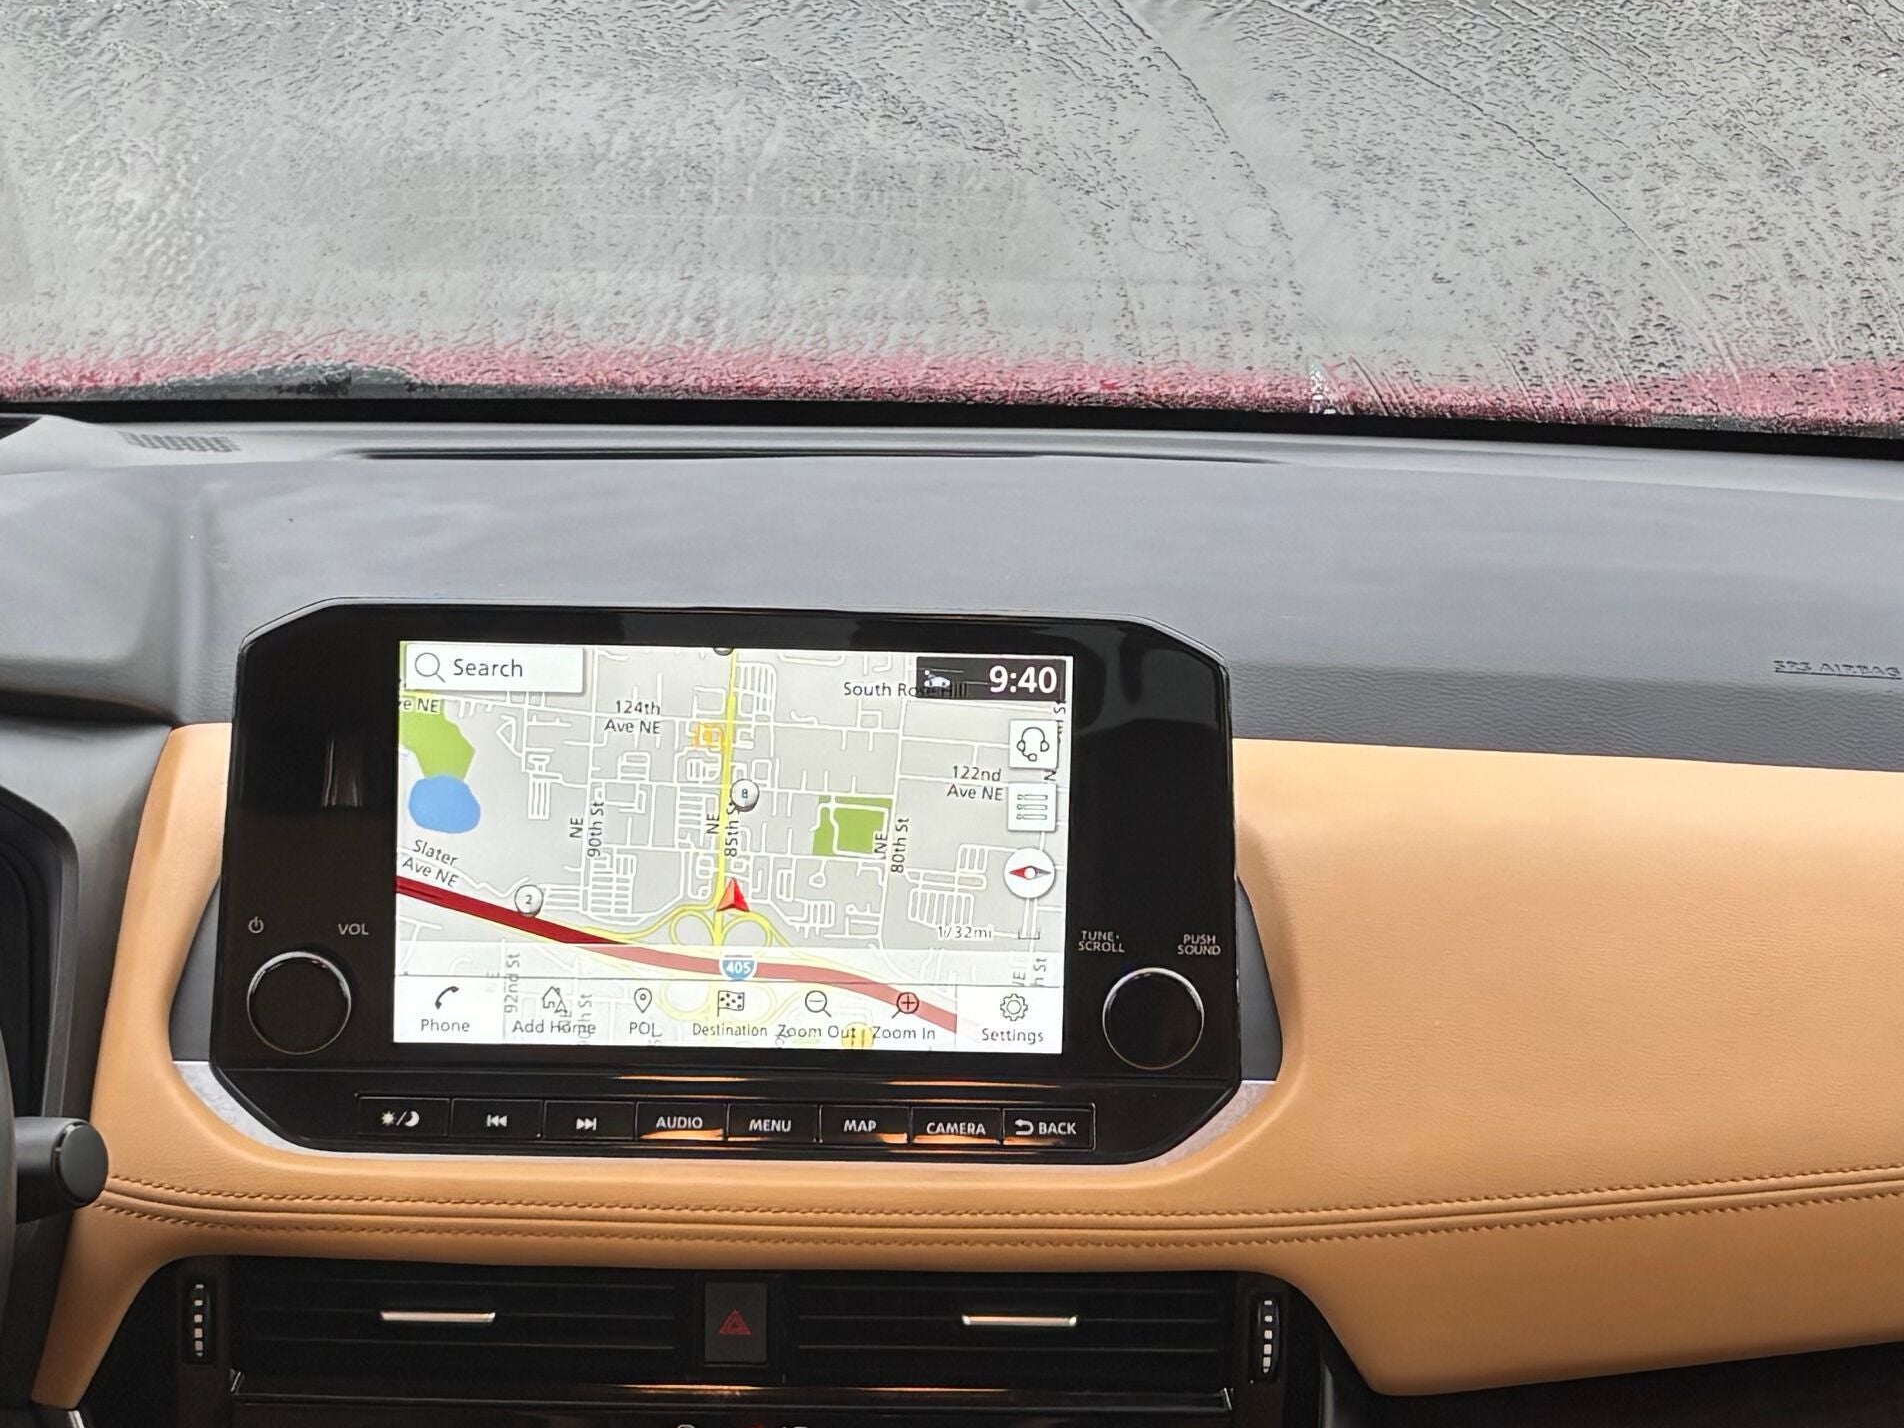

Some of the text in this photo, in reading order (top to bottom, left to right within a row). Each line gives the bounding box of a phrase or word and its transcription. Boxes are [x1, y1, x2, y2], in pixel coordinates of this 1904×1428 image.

[453, 659, 524, 678] Search
[989, 665, 1058, 694] 9:40
[844, 681, 892, 697] South
[417, 698, 440, 713] NE
[615, 700, 662, 716] 124th
[604, 719, 661, 735] Ave NE
[953, 765, 1001, 782] 122nd
[947, 785, 1003, 801] Ave NE
[569, 817, 584, 838] NE
[587, 801, 605, 857] 90th St
[706, 814, 719, 834] NE
[724, 820, 739, 857] 85th
[890, 818, 910, 873] 80th St
[412, 839, 458, 867] Slater
[402, 857, 459, 888] Ave NE
[337, 923, 369, 935] VOL
[1078, 941, 1125, 953] SCROLL
[1183, 934, 1216, 945] PUSH
[1177, 944, 1221, 956] SOUND
[727, 960, 752, 973] 405
[420, 1018, 471, 1033] Phone
[512, 1019, 545, 1034] Add
[549, 1021, 597, 1035] Home
[692, 1022, 768, 1037] Destination
[872, 1025, 936, 1039] Zoom In
[982, 1028, 1044, 1045] Settings
[655, 1115, 704, 1130] AUDIO
[749, 1118, 792, 1133] MENU
[843, 1119, 877, 1133] MAP
[926, 1121, 987, 1136] CAMERA
[1038, 1121, 1077, 1135] BACK
